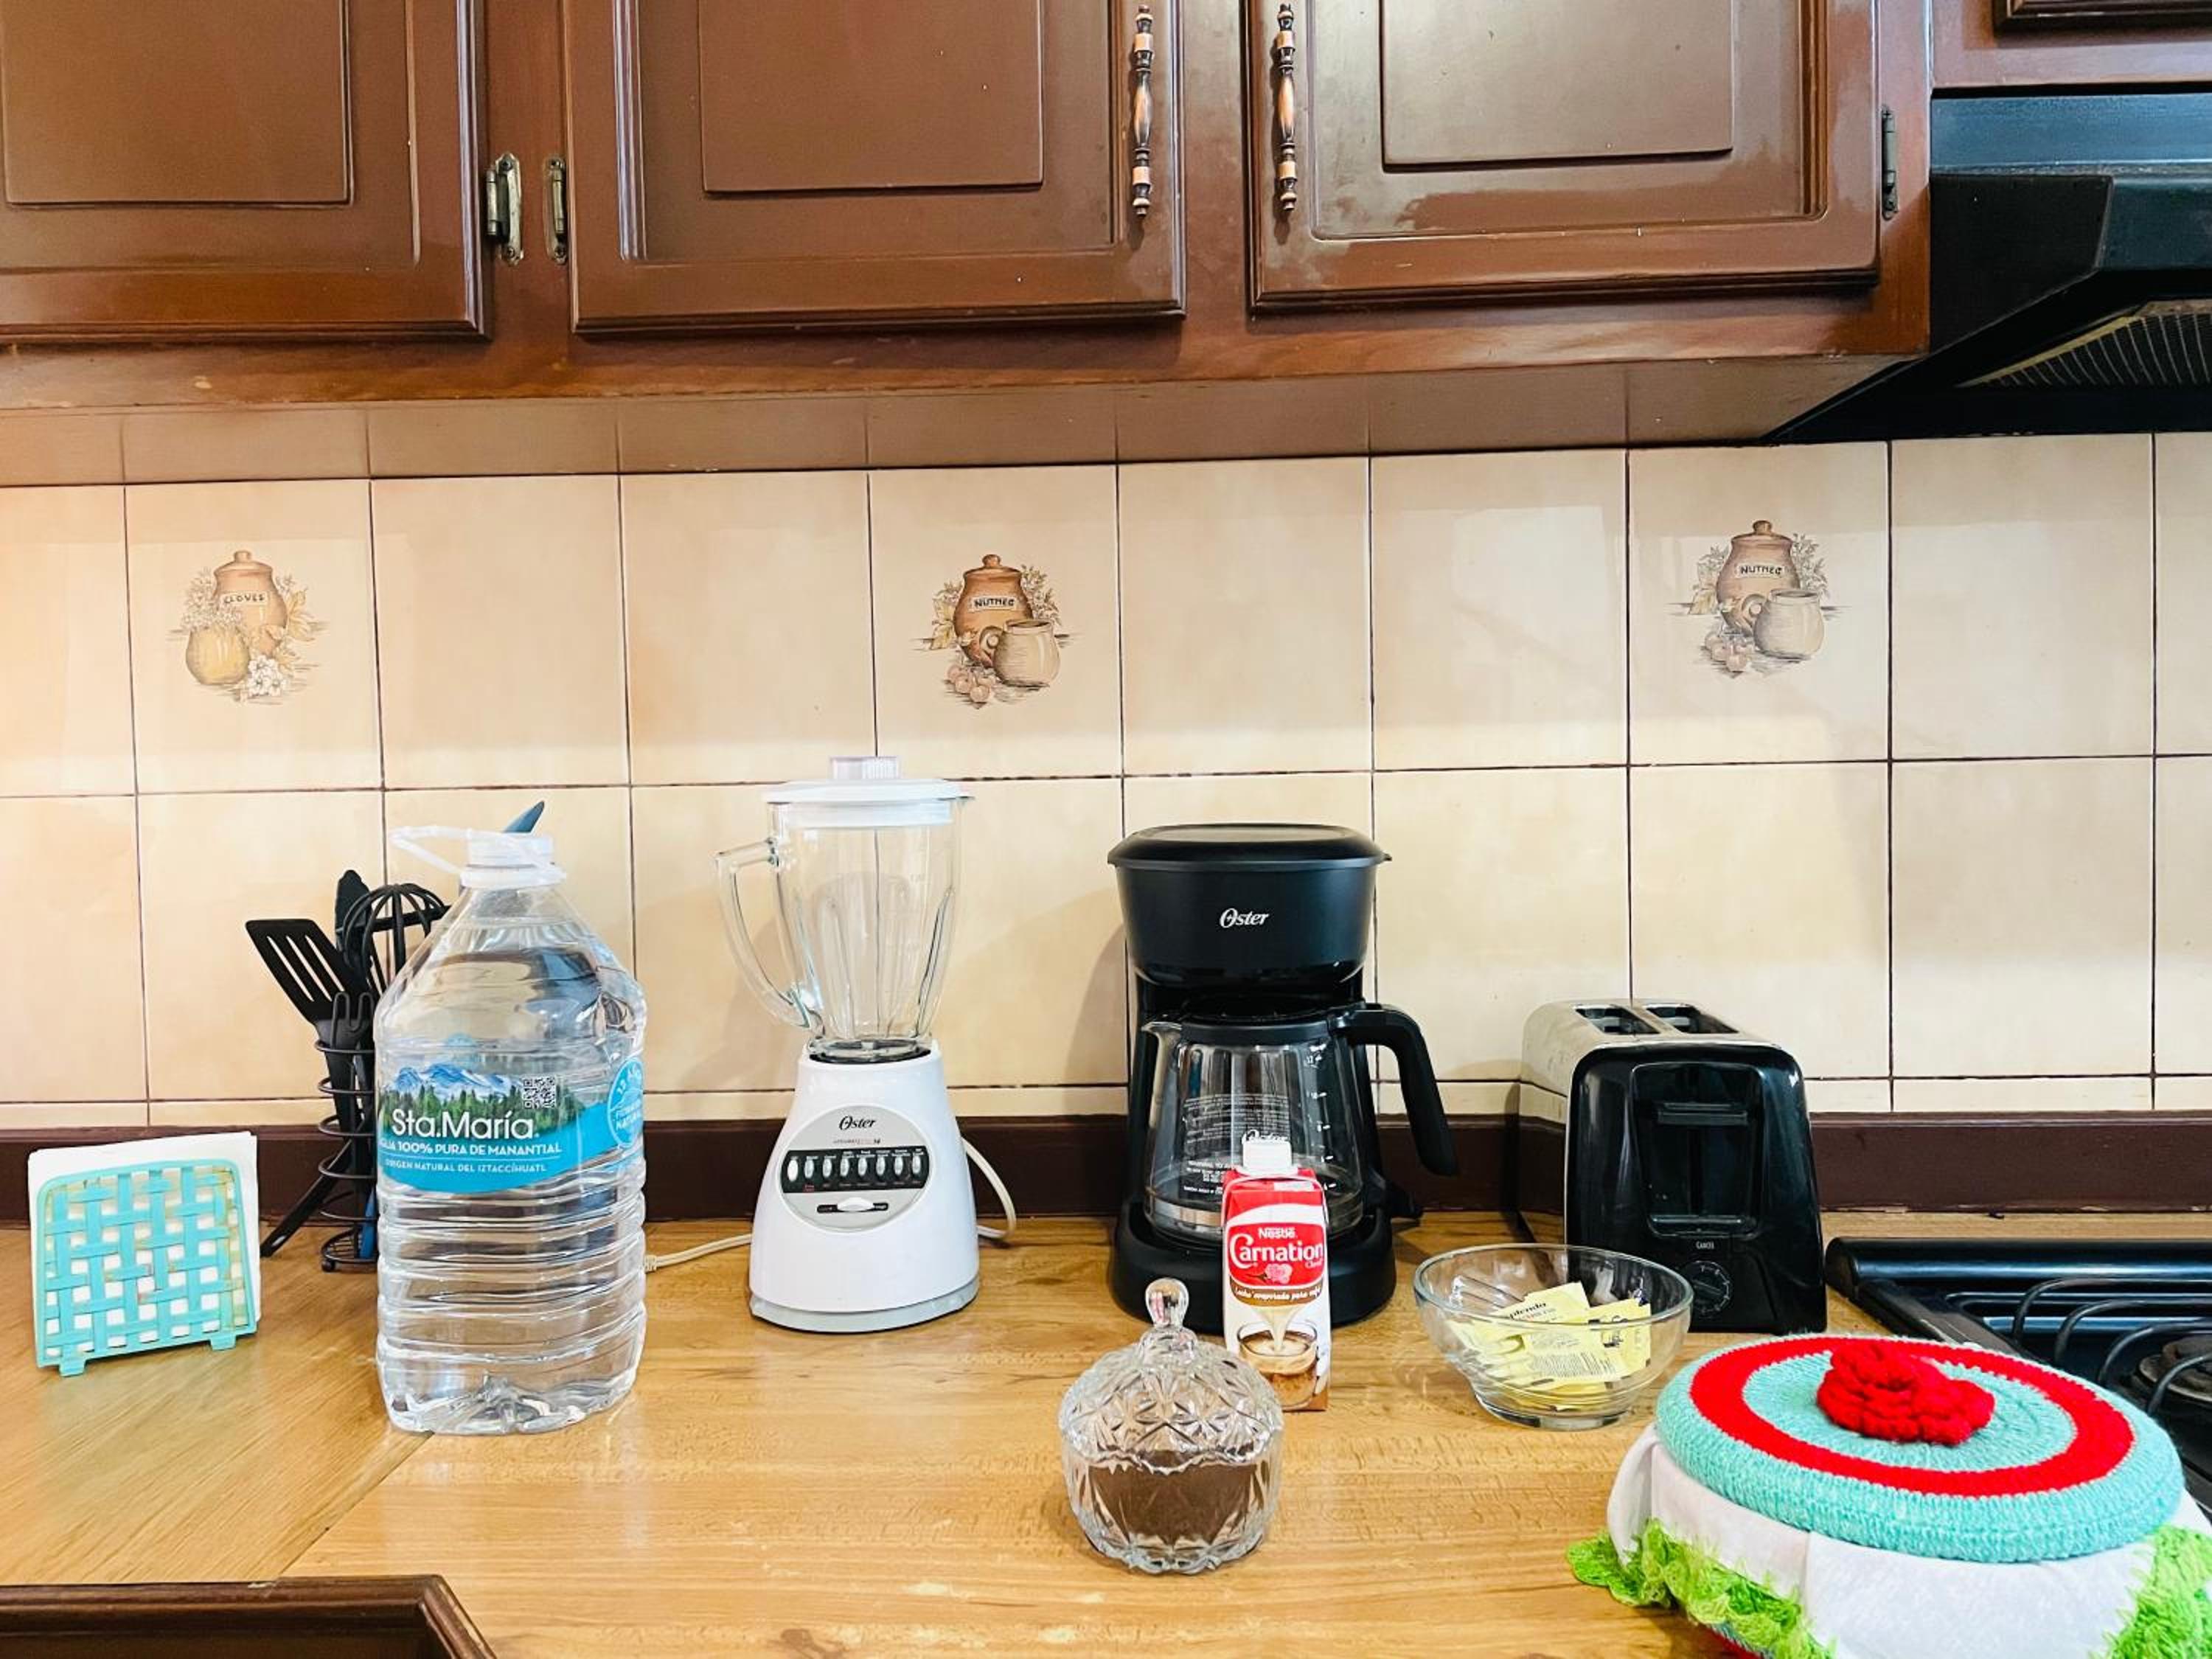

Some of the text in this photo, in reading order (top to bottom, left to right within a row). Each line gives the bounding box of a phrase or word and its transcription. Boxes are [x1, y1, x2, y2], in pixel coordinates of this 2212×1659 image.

[1740, 565, 1783, 575] NUTMEG
[223, 593, 266, 605] CLOVES
[974, 597, 1016, 608] NUTMEG
[1220, 908, 1270, 928] Oster
[838, 1115, 877, 1130] Oster
[398, 1141, 434, 1155] 100%
[435, 1144, 467, 1155] PURA
[470, 1144, 487, 1155] DE
[487, 1141, 563, 1156] MANANTIAL
[414, 1161, 455, 1172] NATURAL
[458, 1164, 476, 1173] DEL
[1229, 1233, 1324, 1270] Carnation
